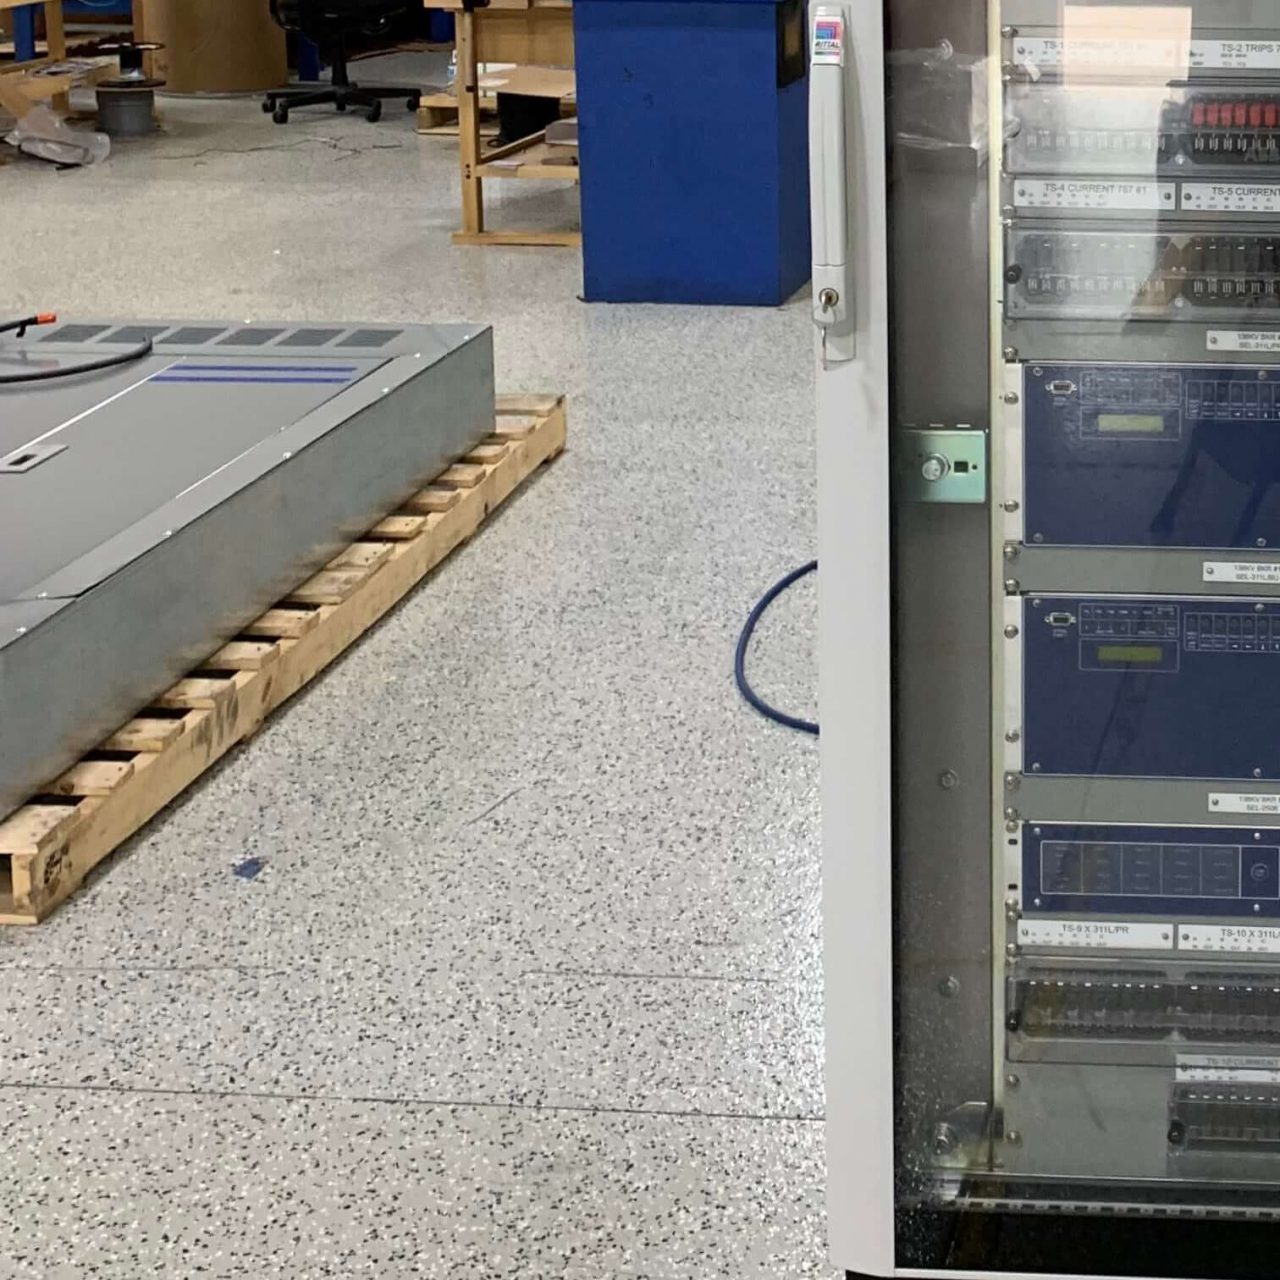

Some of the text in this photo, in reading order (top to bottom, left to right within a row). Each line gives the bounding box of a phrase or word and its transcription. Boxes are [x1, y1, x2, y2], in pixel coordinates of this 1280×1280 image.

[815, 41, 840, 49] RITTAL
[1220, 43, 1242, 52] TS-2
[1245, 44, 1274, 53] TRIPS
[1044, 184, 1065, 192] TS-4
[1068, 184, 1115, 193] CURRENT
[1212, 186, 1234, 196] TS-5
[1062, 924, 1082, 932] TS-9
[1220, 928, 1246, 938] TS-10
[1249, 929, 1256, 938] X
